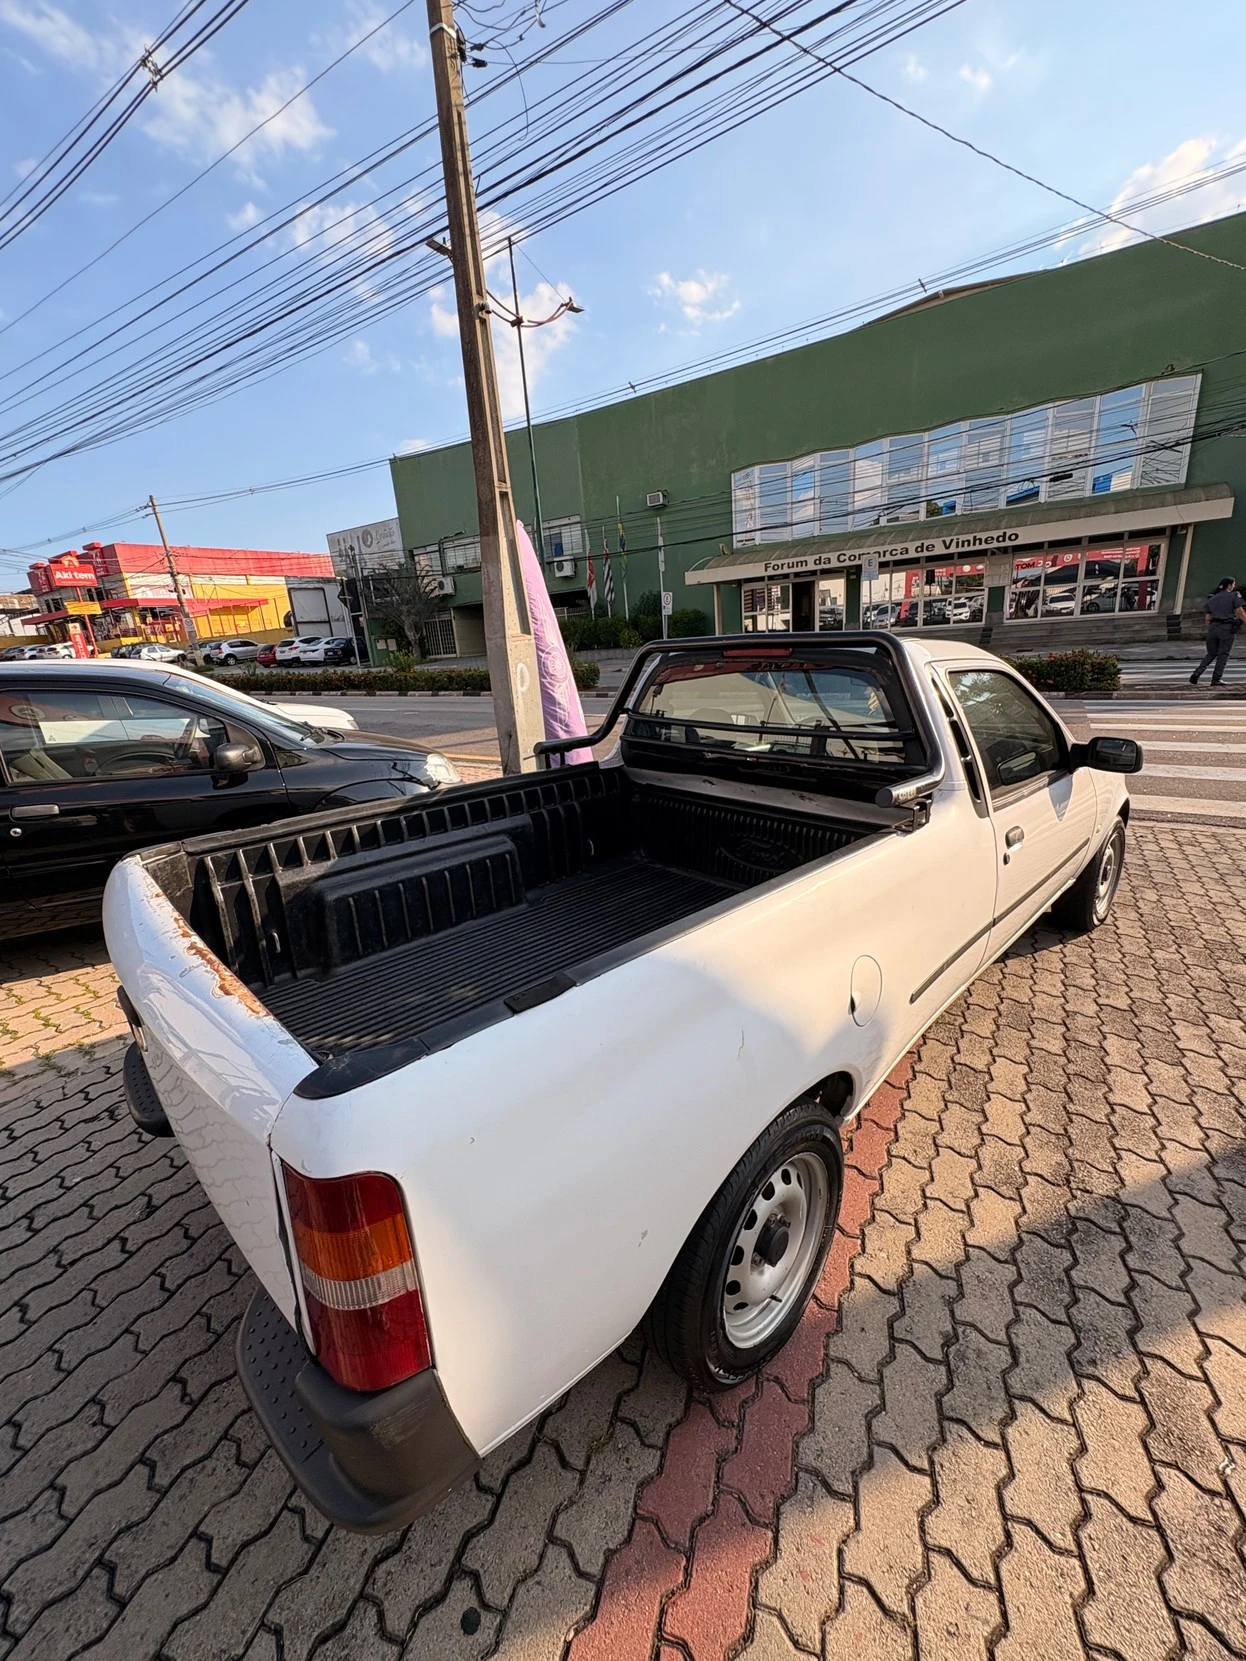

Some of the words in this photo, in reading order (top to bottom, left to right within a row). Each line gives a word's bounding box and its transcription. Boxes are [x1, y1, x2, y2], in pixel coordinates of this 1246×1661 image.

[764, 559, 808, 572] Forum
[813, 555, 831, 566] da
[914, 542, 936, 554] de
[941, 531, 1020, 550] Vinhedo
[74, 571, 95, 579] tem
